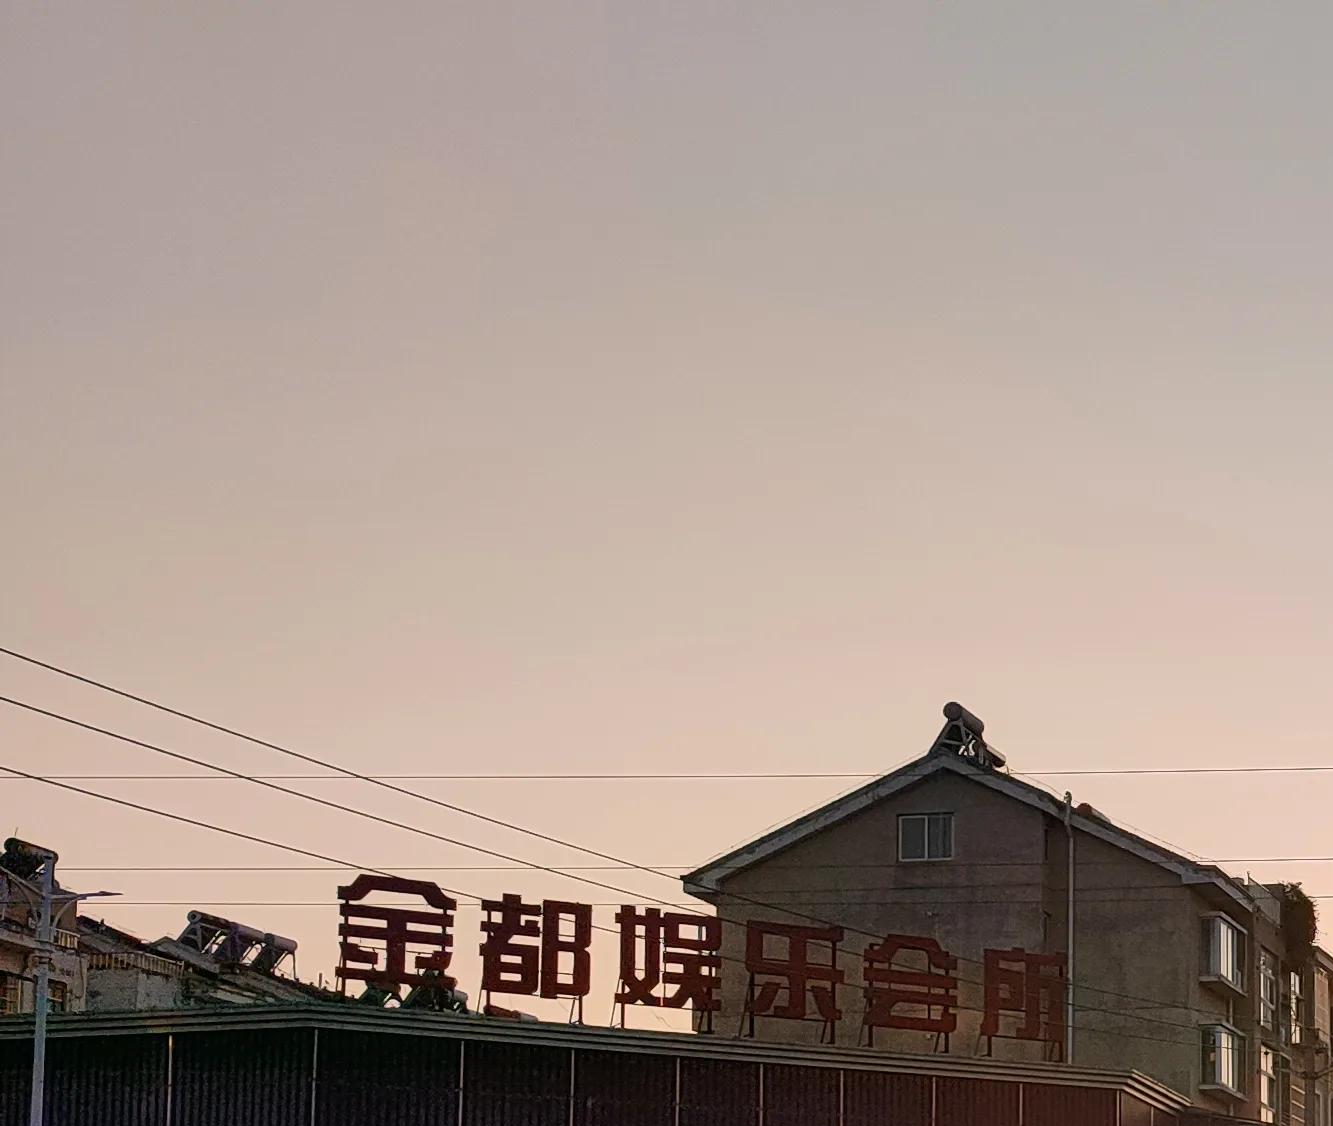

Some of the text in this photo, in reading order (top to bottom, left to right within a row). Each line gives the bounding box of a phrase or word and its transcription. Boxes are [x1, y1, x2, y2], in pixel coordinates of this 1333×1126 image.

[336, 873, 1068, 1042] 金都娱乐会所
